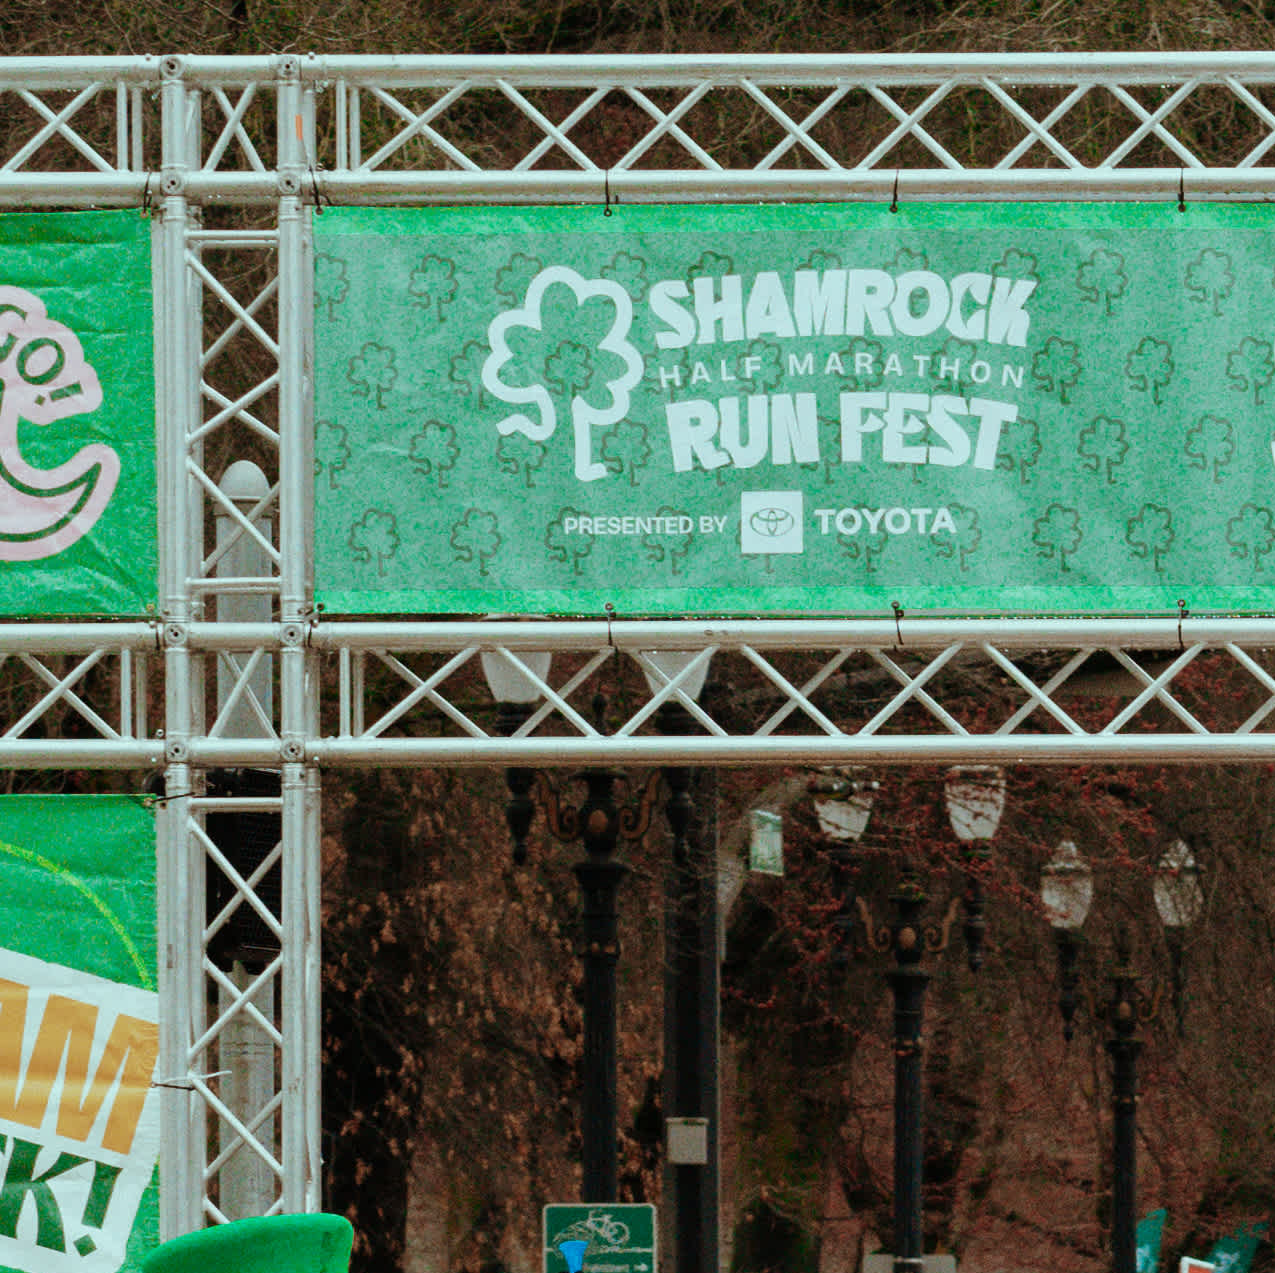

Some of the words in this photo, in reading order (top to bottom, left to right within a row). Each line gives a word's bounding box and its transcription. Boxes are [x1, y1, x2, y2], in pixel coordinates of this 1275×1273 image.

[649, 268, 1039, 349] SHAMROCK
[658, 355, 763, 388] HALF
[788, 352, 1026, 388] MARATHON
[665, 392, 821, 473] RUN
[840, 391, 1019, 470] FEST
[563, 516, 693, 535] PRESENTED
[698, 516, 728, 534] BY
[814, 508, 958, 535] TOYOTA
[0, 1132, 123, 1257] K!
